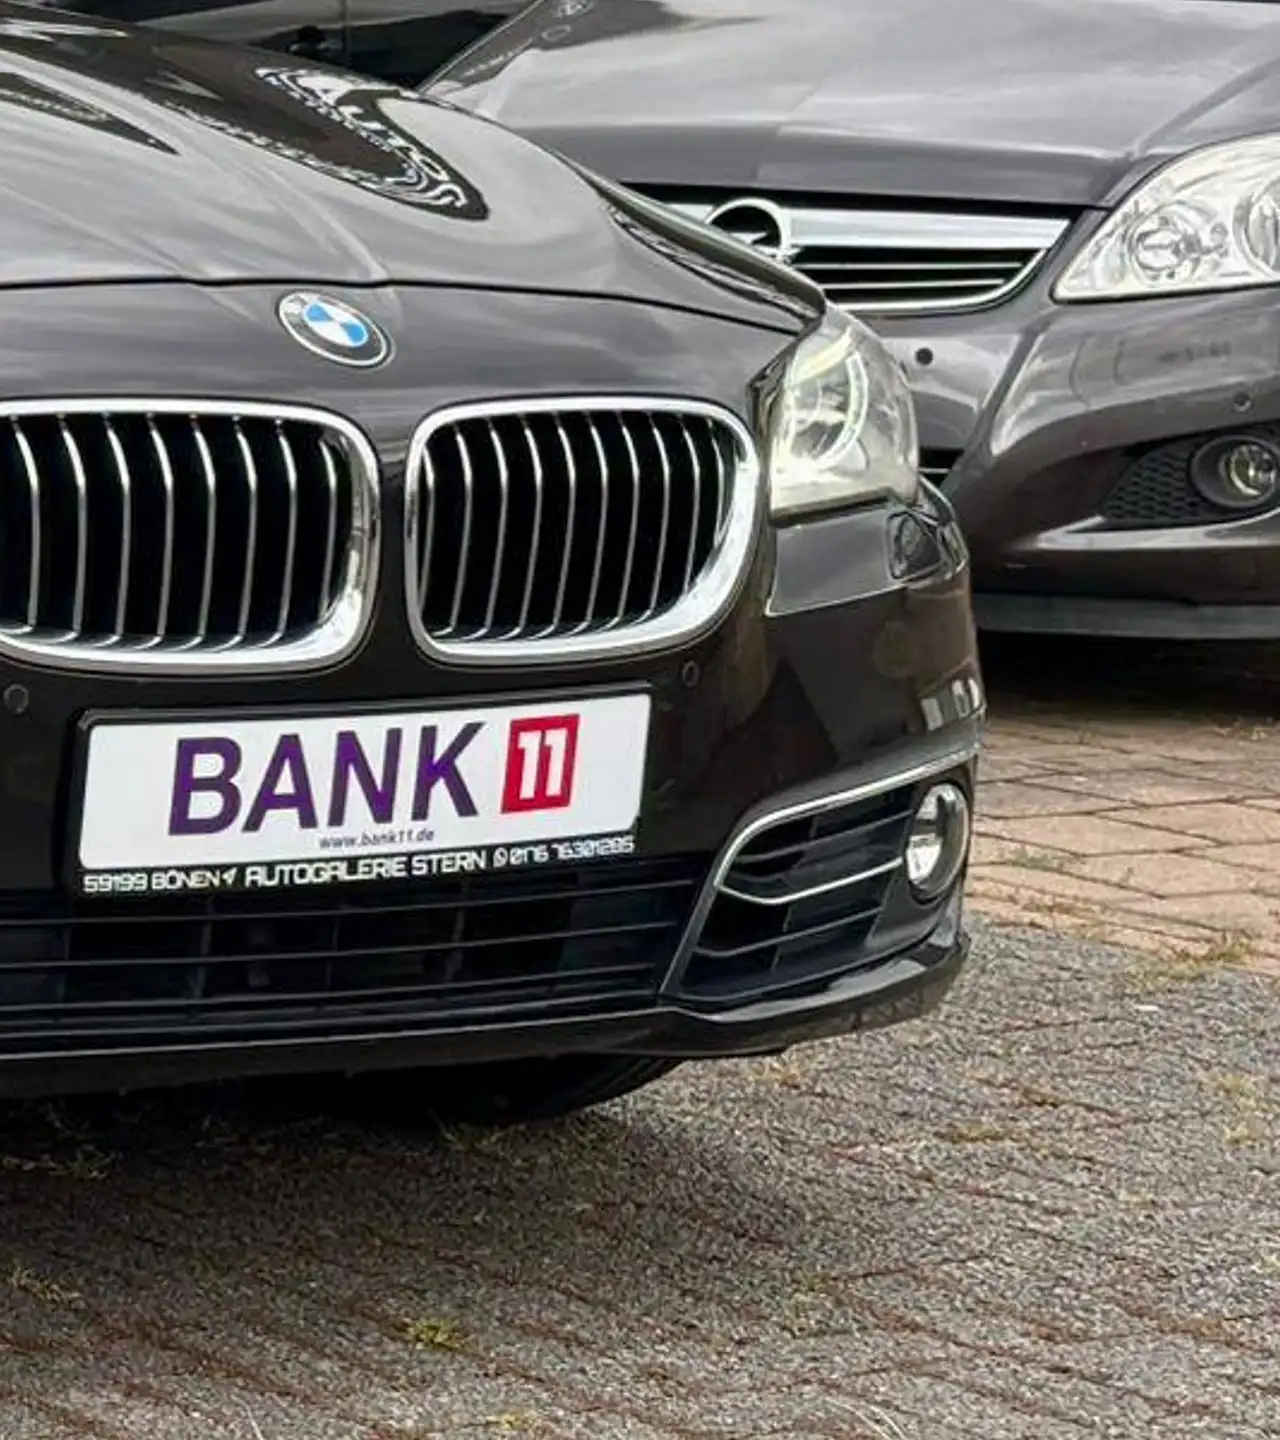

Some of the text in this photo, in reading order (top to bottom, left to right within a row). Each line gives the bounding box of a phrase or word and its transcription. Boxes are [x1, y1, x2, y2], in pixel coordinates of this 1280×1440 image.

[168, 721, 485, 837] BANK
[319, 828, 435, 849] www.bank11.de
[245, 859, 407, 887] AUTOGALERIE
[411, 849, 487, 877] STERN
